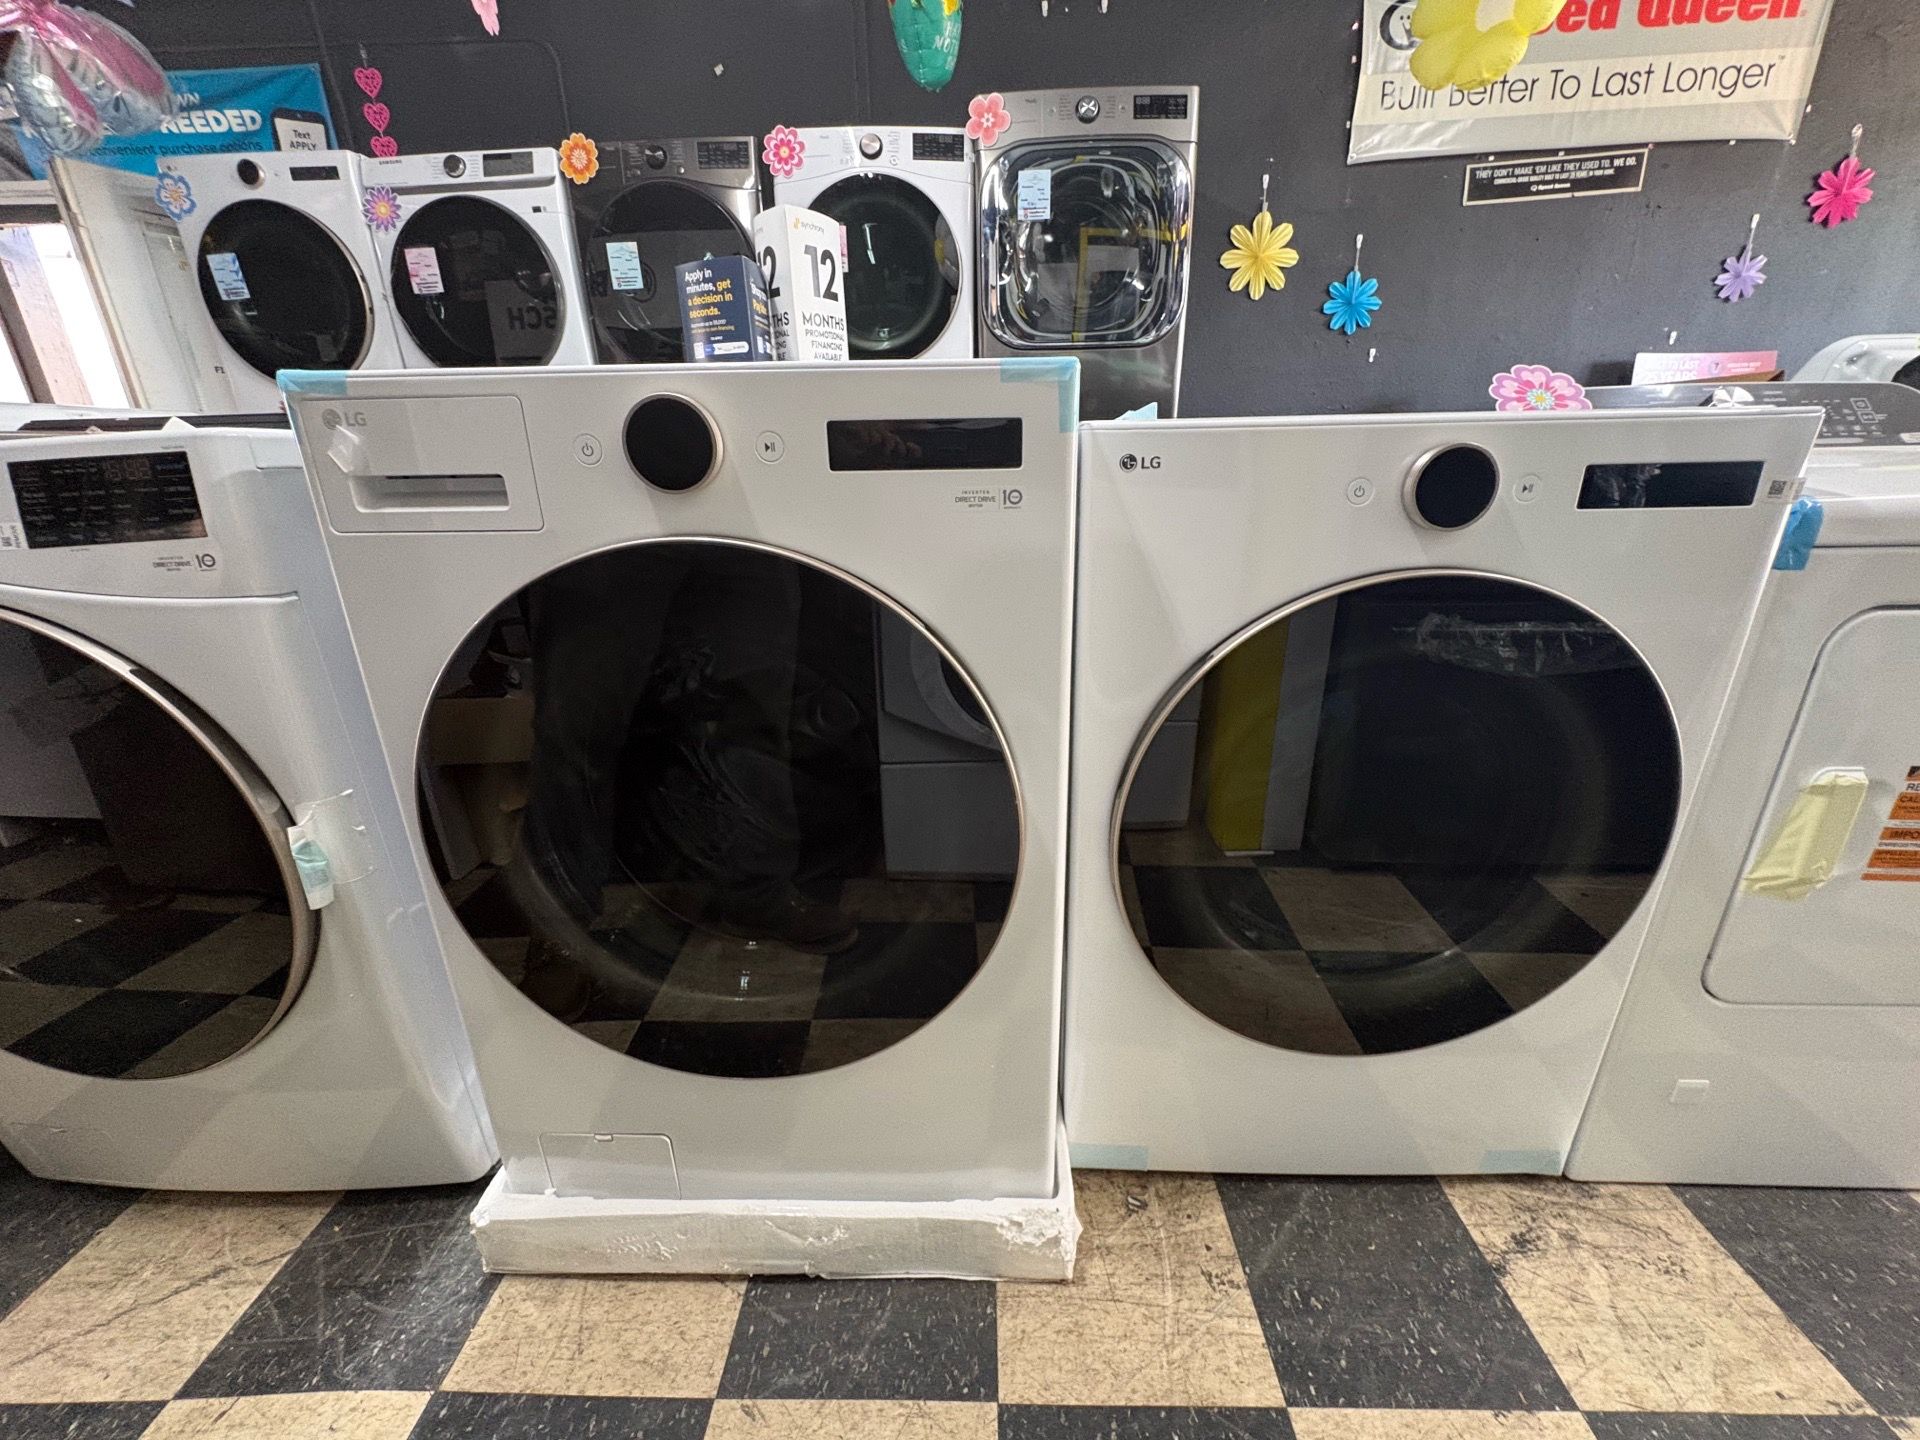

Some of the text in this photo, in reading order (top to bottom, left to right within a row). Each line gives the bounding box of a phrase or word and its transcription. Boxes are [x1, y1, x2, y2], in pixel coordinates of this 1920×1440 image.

[1550, 69, 1581, 100] To
[1591, 62, 1655, 98] Last
[1662, 61, 1776, 99] Longer
[160, 109, 262, 134] NEEDED
[292, 129, 312, 140] Text
[159, 143, 219, 156] purchase
[221, 140, 264, 152] options
[290, 140, 317, 152] APPLY
[1475, 168, 1493, 179] THEY
[1514, 166, 1534, 176] MAKE
[1548, 164, 1562, 173] LIKE
[1563, 163, 1580, 172] THEY
[1581, 161, 1599, 170] USED
[1613, 158, 1625, 167] WE
[685, 268, 712, 283] Apply in
[804, 244, 839, 302] 12
[716, 279, 731, 291] get
[693, 293, 724, 305] decision
[724, 292, 733, 301] in
[689, 306, 721, 319] seconds.
[802, 311, 844, 331] MONTHS
[805, 328, 845, 342] PROMOTIONAL
[811, 340, 843, 351] FINANCING
[344, 412, 367, 427] LG
[1141, 456, 1161, 470] LG
[1002, 489, 1023, 505] 10
[195, 553, 216, 569] 10
